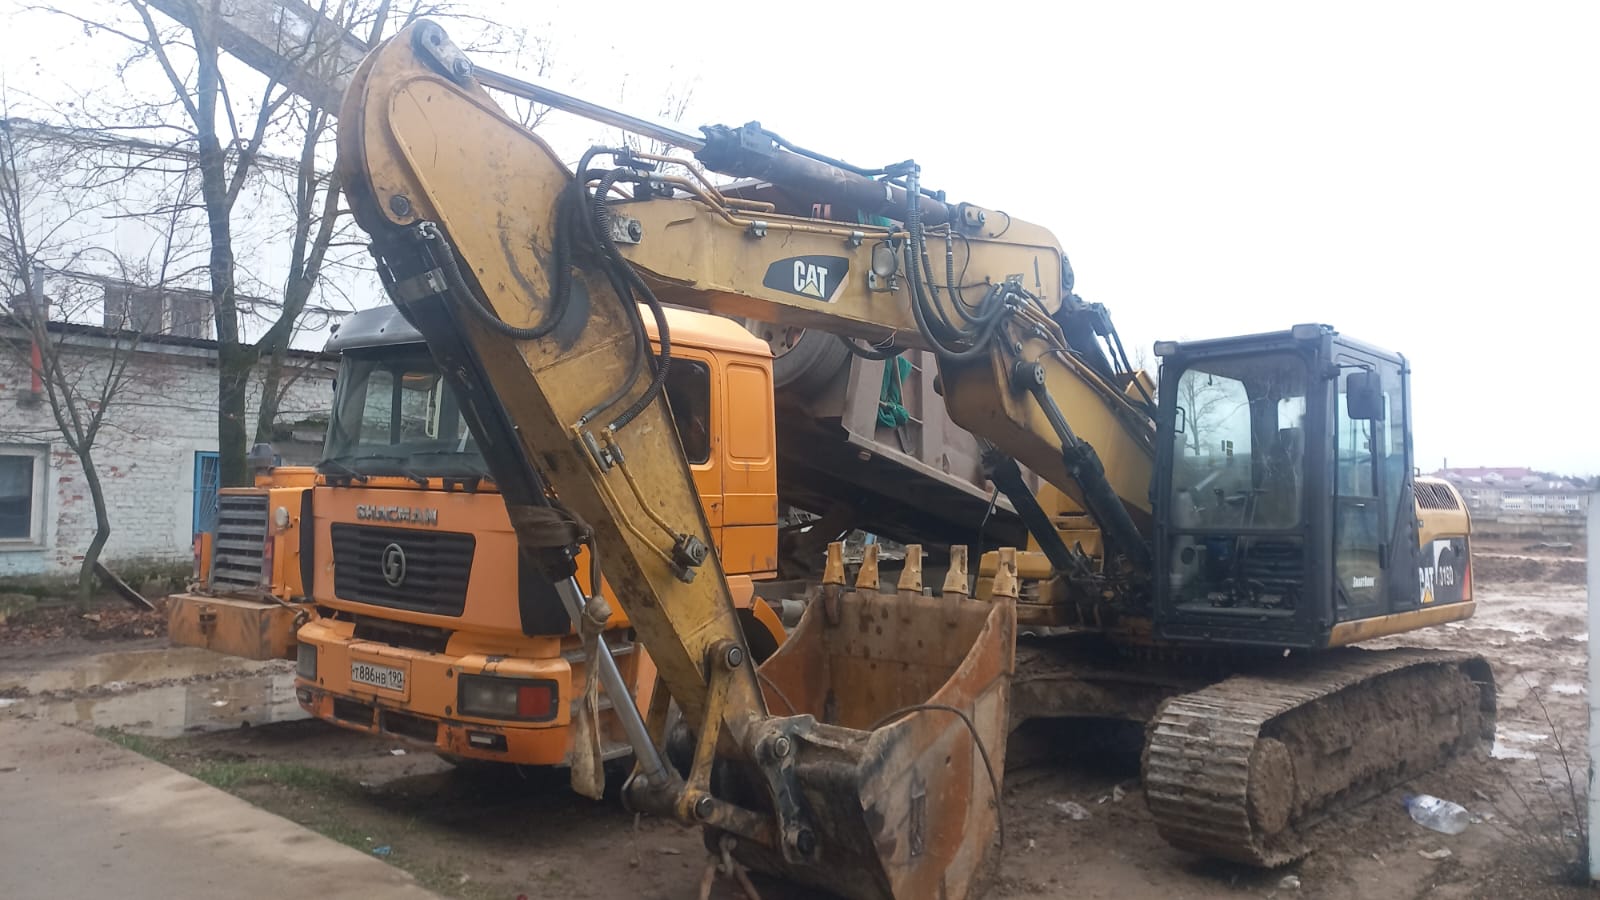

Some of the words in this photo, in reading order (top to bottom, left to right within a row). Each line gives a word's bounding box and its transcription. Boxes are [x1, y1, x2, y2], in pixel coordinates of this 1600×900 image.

[794, 260, 828, 298] CAT
[356, 504, 438, 526] SHACMAN
[1418, 567, 1435, 603] CAT
